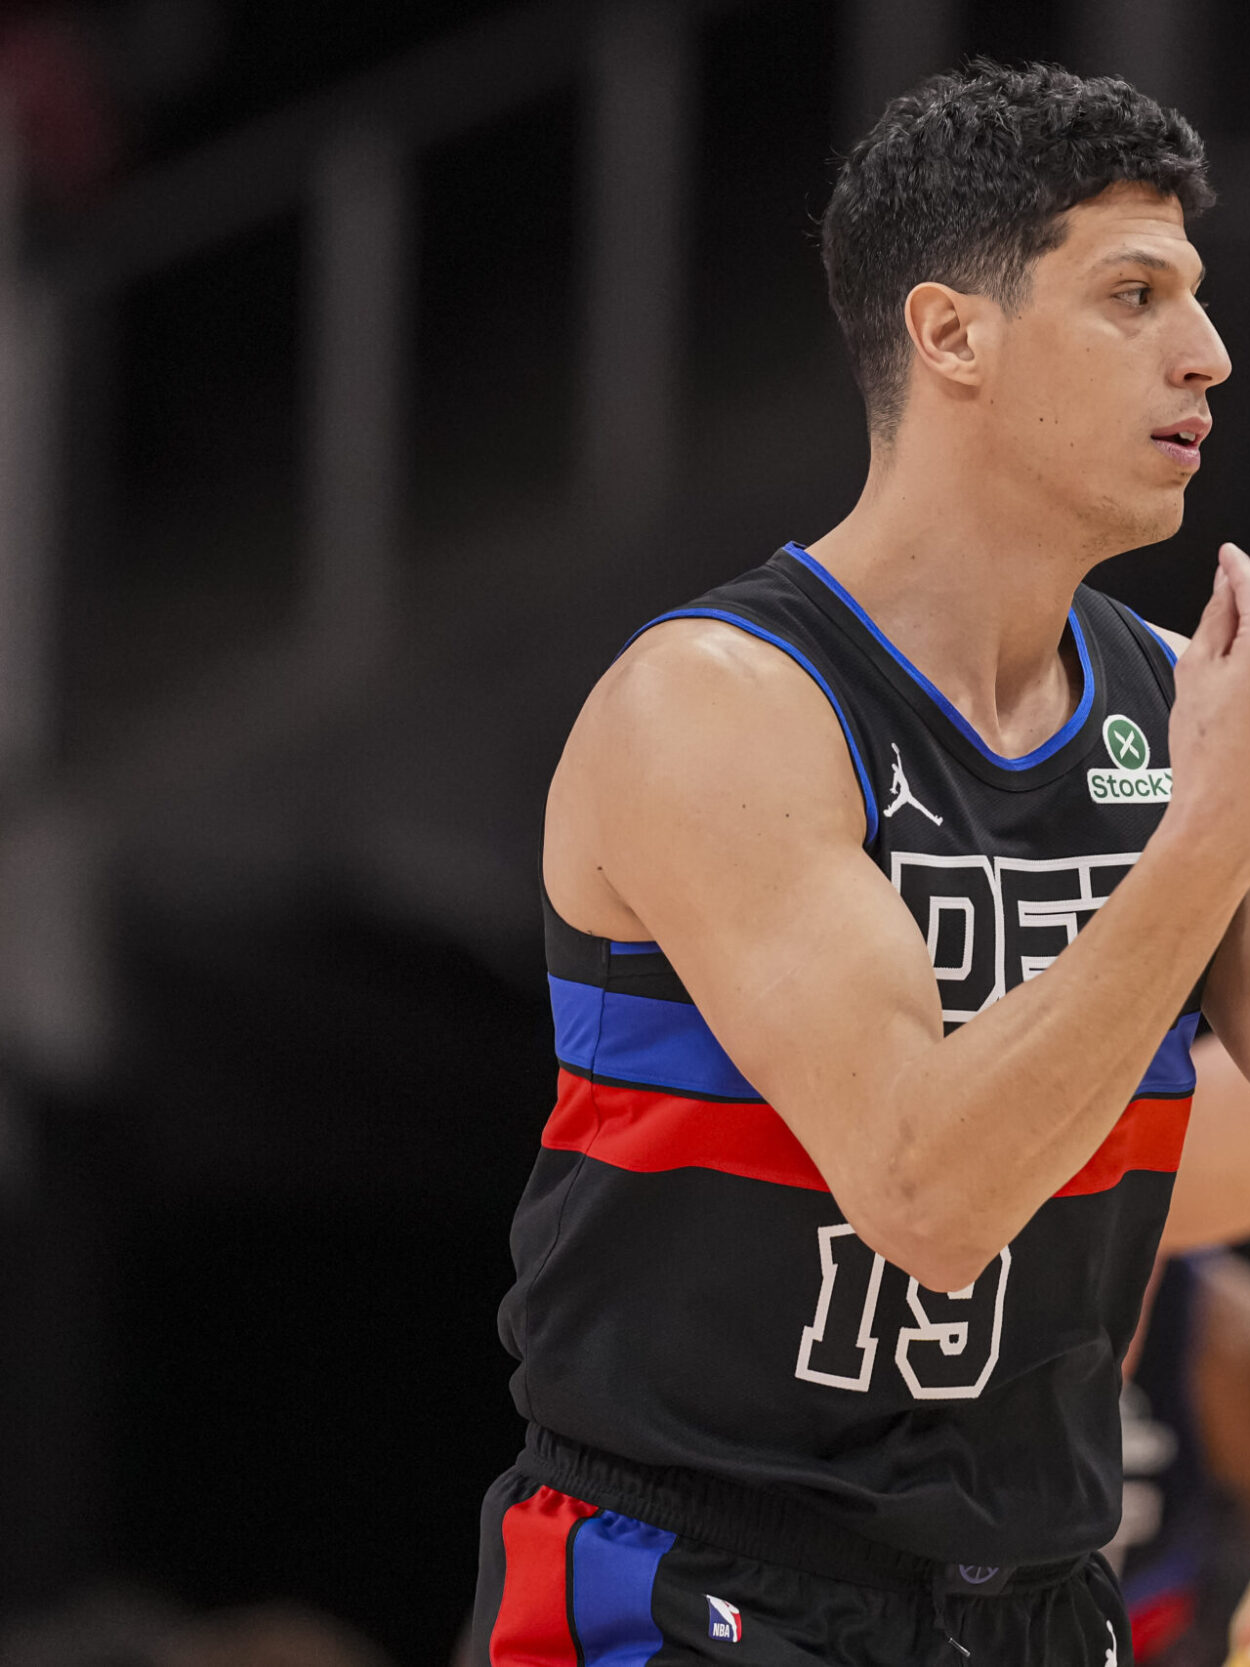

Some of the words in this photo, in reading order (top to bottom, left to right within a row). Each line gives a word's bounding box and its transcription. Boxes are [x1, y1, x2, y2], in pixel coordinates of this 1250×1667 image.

[1091, 773, 1173, 798] Stock
[795, 1223, 1012, 1399] 19
[713, 1623, 730, 1638] NBA
